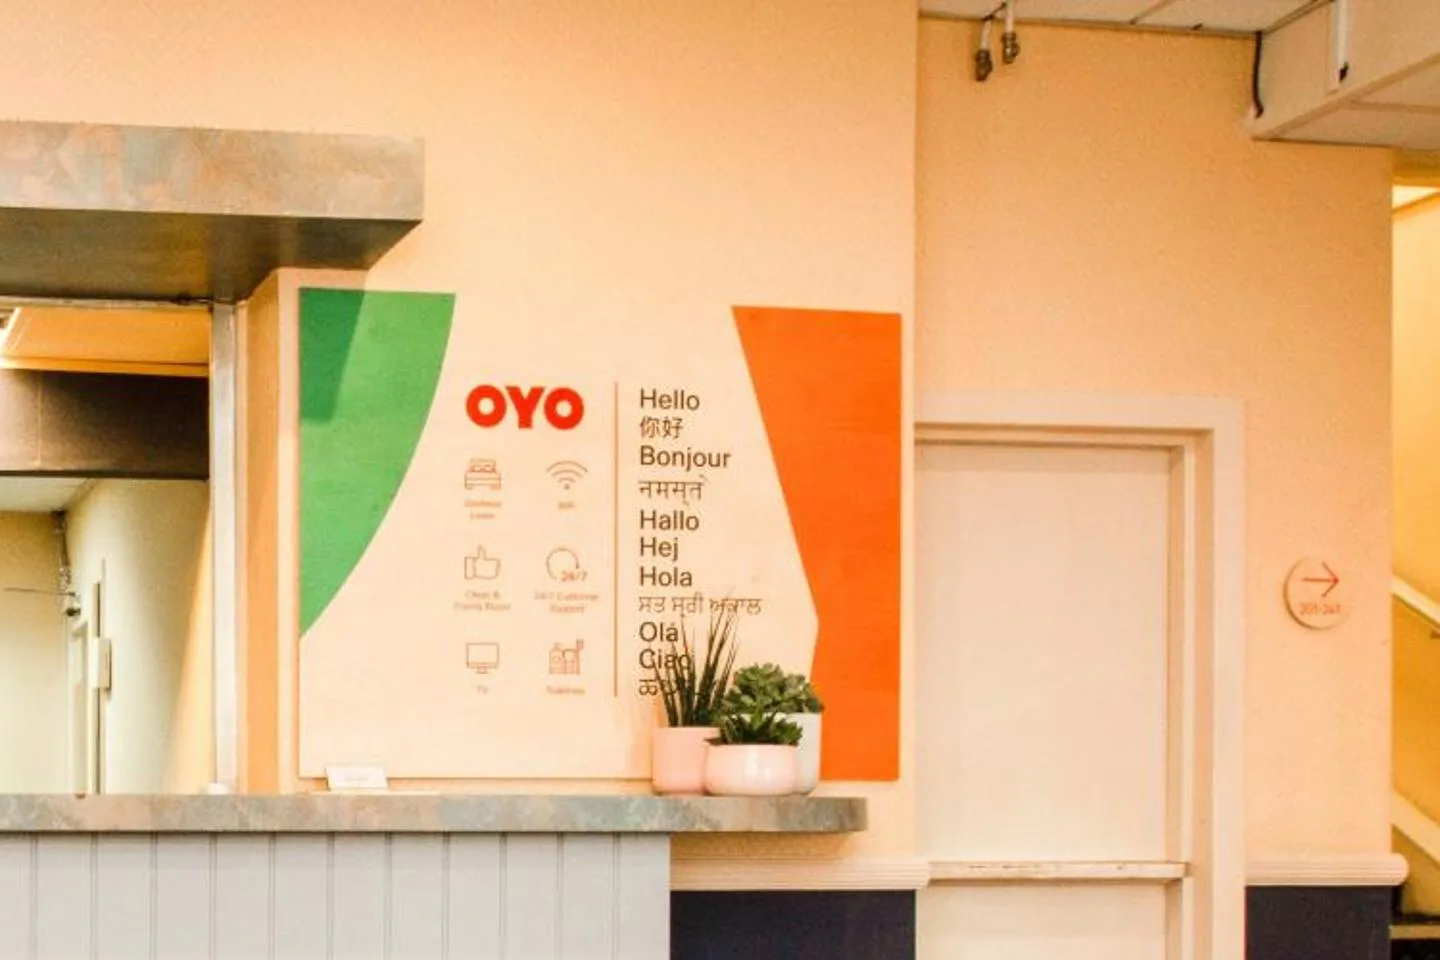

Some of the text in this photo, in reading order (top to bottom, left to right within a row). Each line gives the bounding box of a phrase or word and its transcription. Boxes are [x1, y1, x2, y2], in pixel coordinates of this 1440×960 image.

[465, 384, 585, 431] OYO
[639, 388, 701, 411] Hello
[638, 415, 684, 439] 你好
[639, 445, 731, 472] Bonjour
[639, 509, 700, 531] Hallo
[639, 536, 679, 562] Hej
[639, 566, 693, 587] Hola
[639, 647, 693, 670] Ciao
